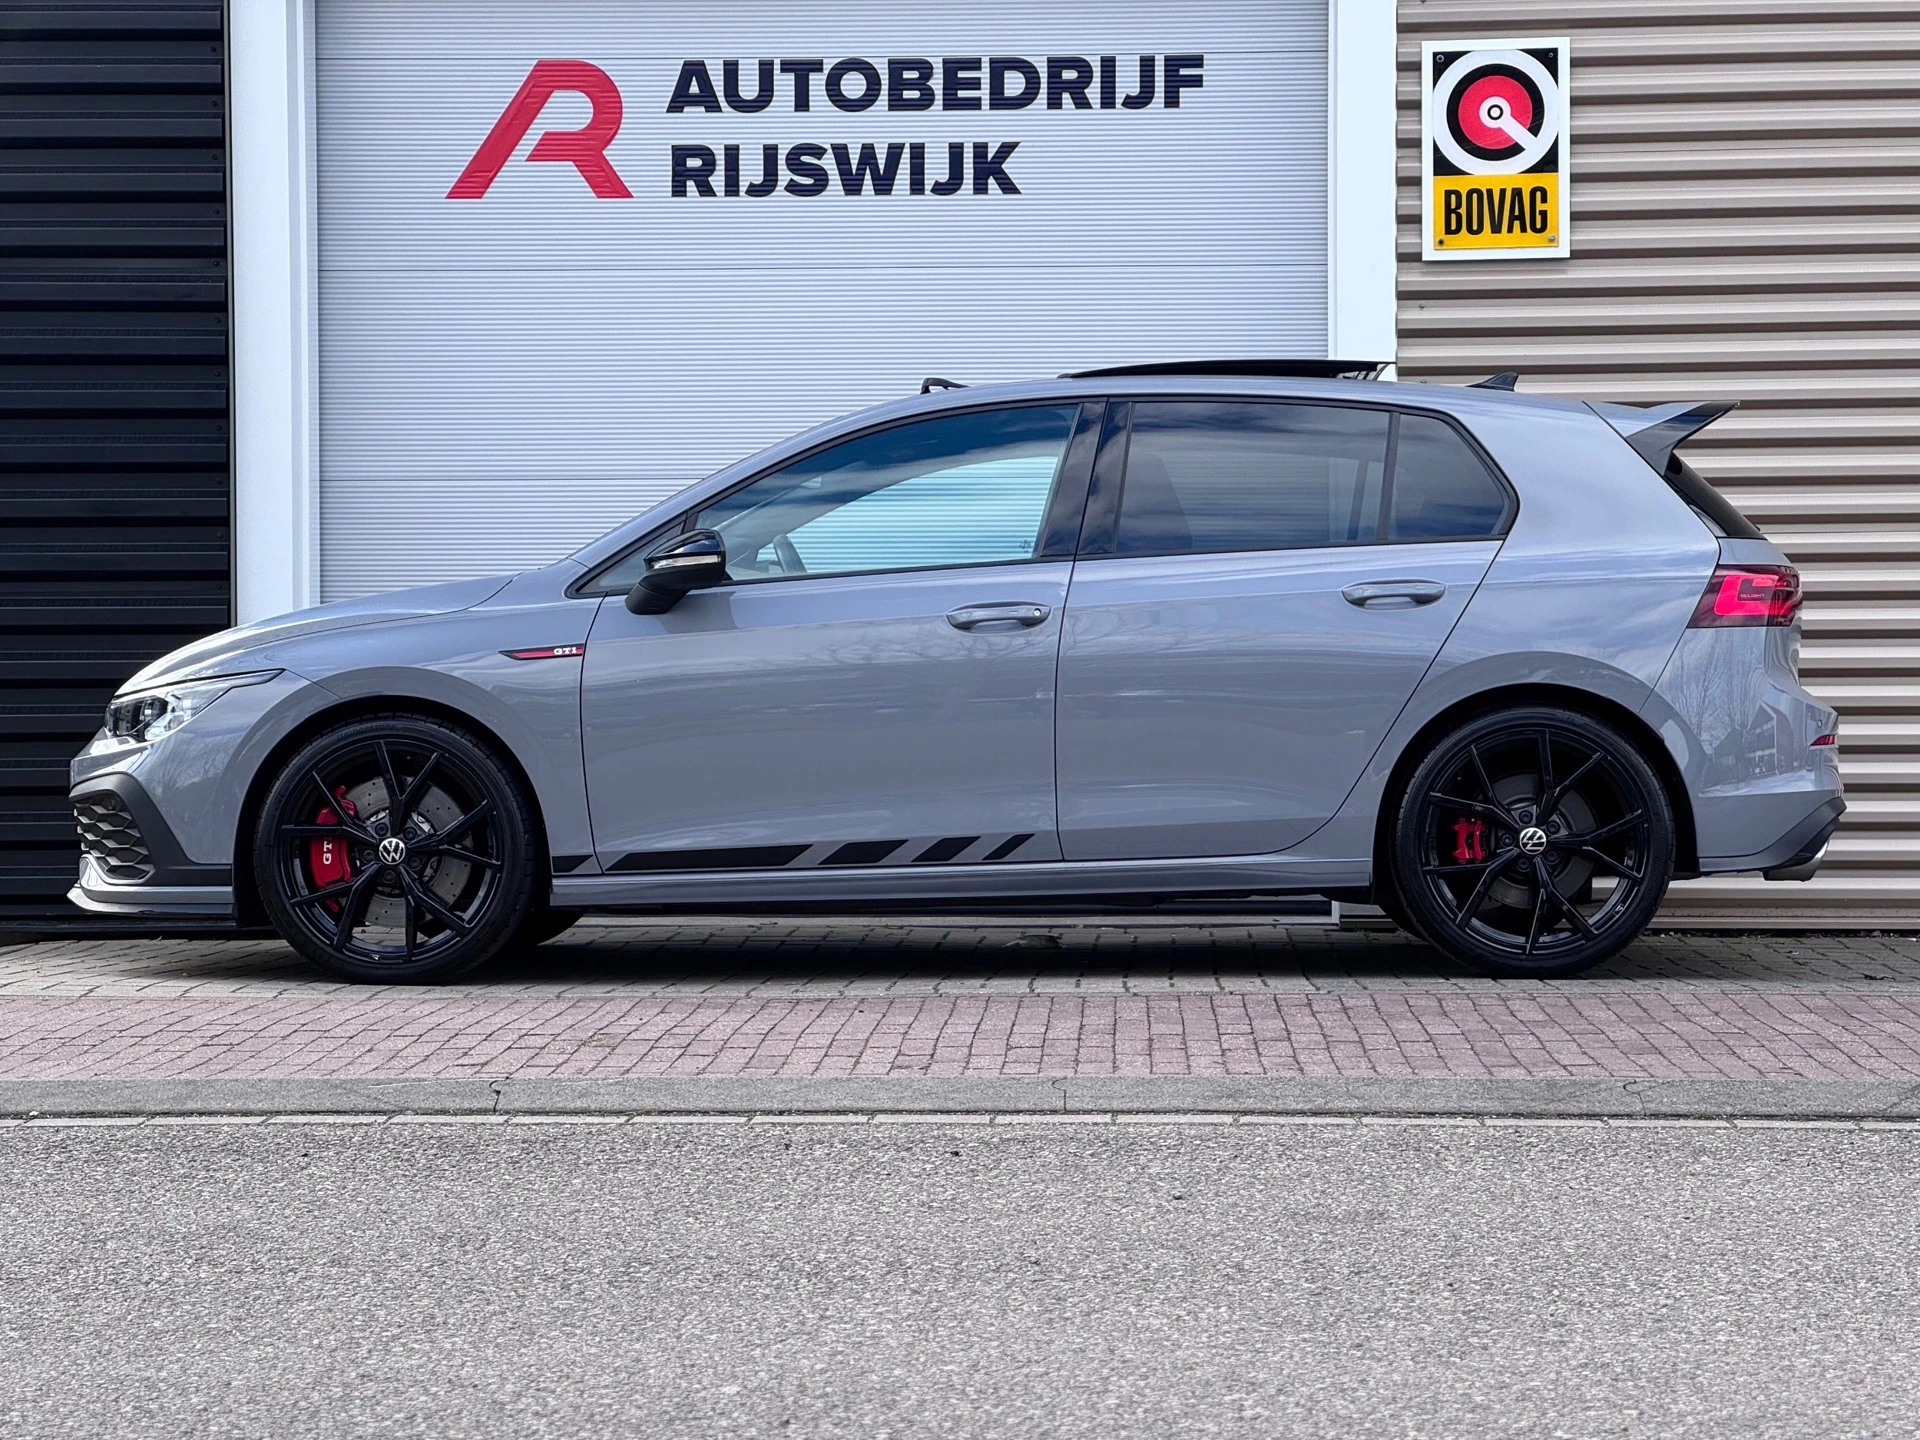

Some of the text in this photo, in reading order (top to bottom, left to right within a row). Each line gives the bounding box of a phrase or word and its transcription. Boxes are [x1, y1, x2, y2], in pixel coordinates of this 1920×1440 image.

[666, 54, 1205, 113] AUTOBEDRIJF
[670, 141, 1020, 198] RIJSWIJK
[1444, 185, 1548, 236] BOVAG
[553, 646, 577, 655] GTI
